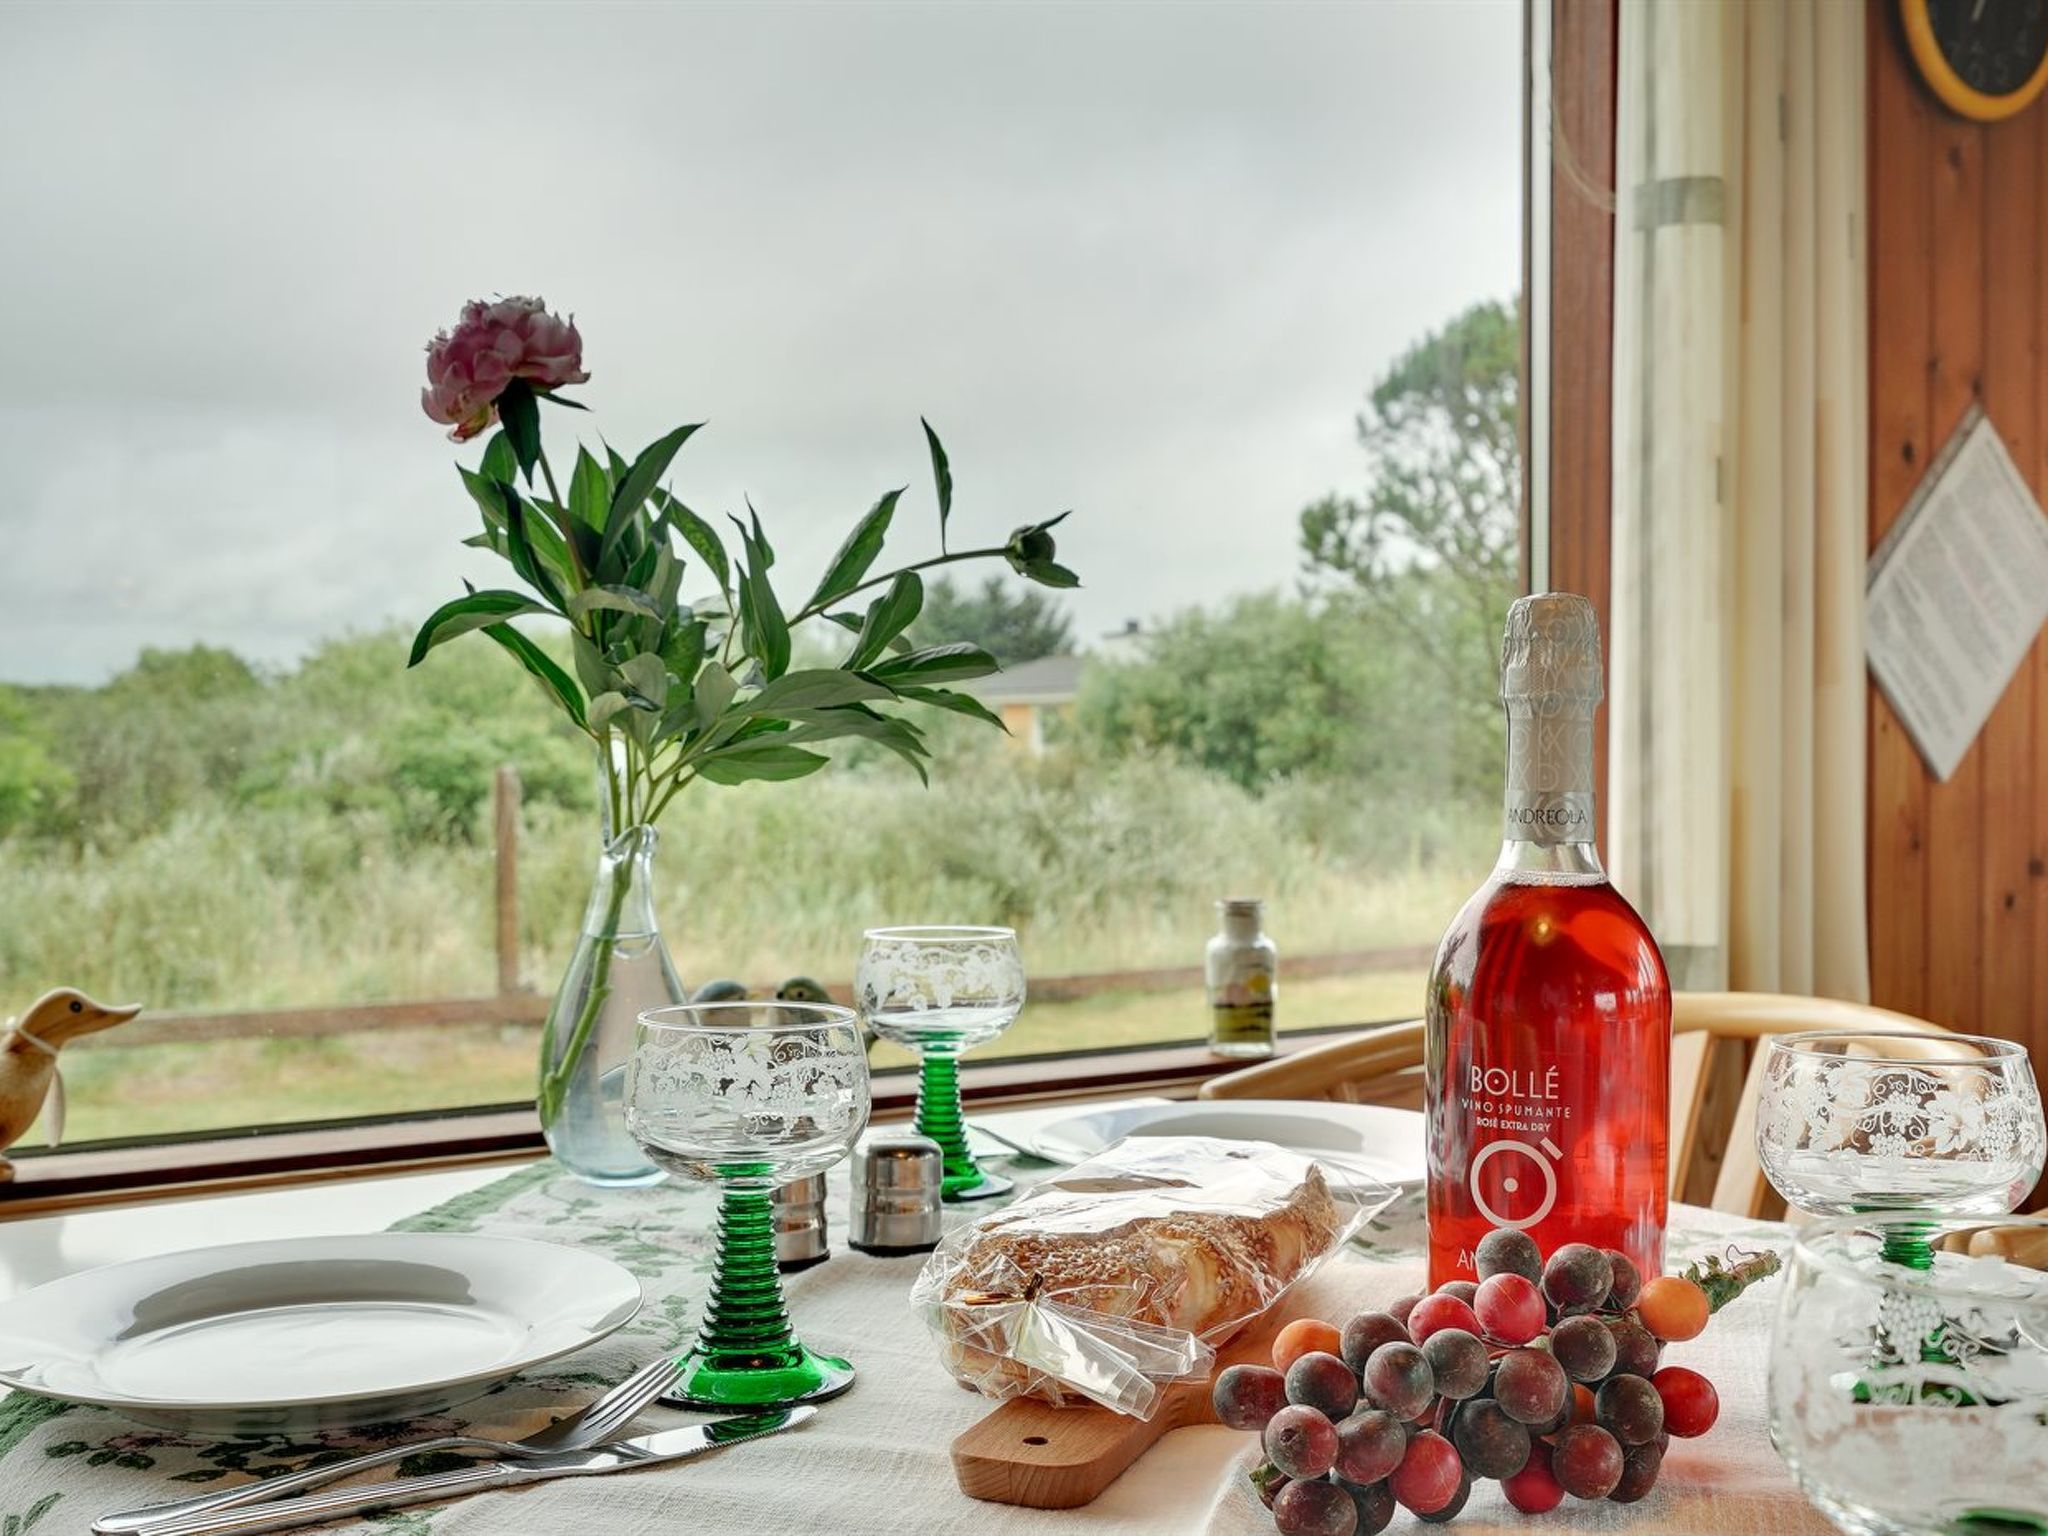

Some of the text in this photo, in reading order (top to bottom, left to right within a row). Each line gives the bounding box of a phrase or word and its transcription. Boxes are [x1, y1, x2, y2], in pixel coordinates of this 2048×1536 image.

[1471, 1065, 1559, 1099] BOLLÉ
[1461, 1097, 1571, 1119] VINO SPUMANTE
[1500, 1119, 1529, 1131] EXTRA
[1530, 1122, 1552, 1133] DRY
